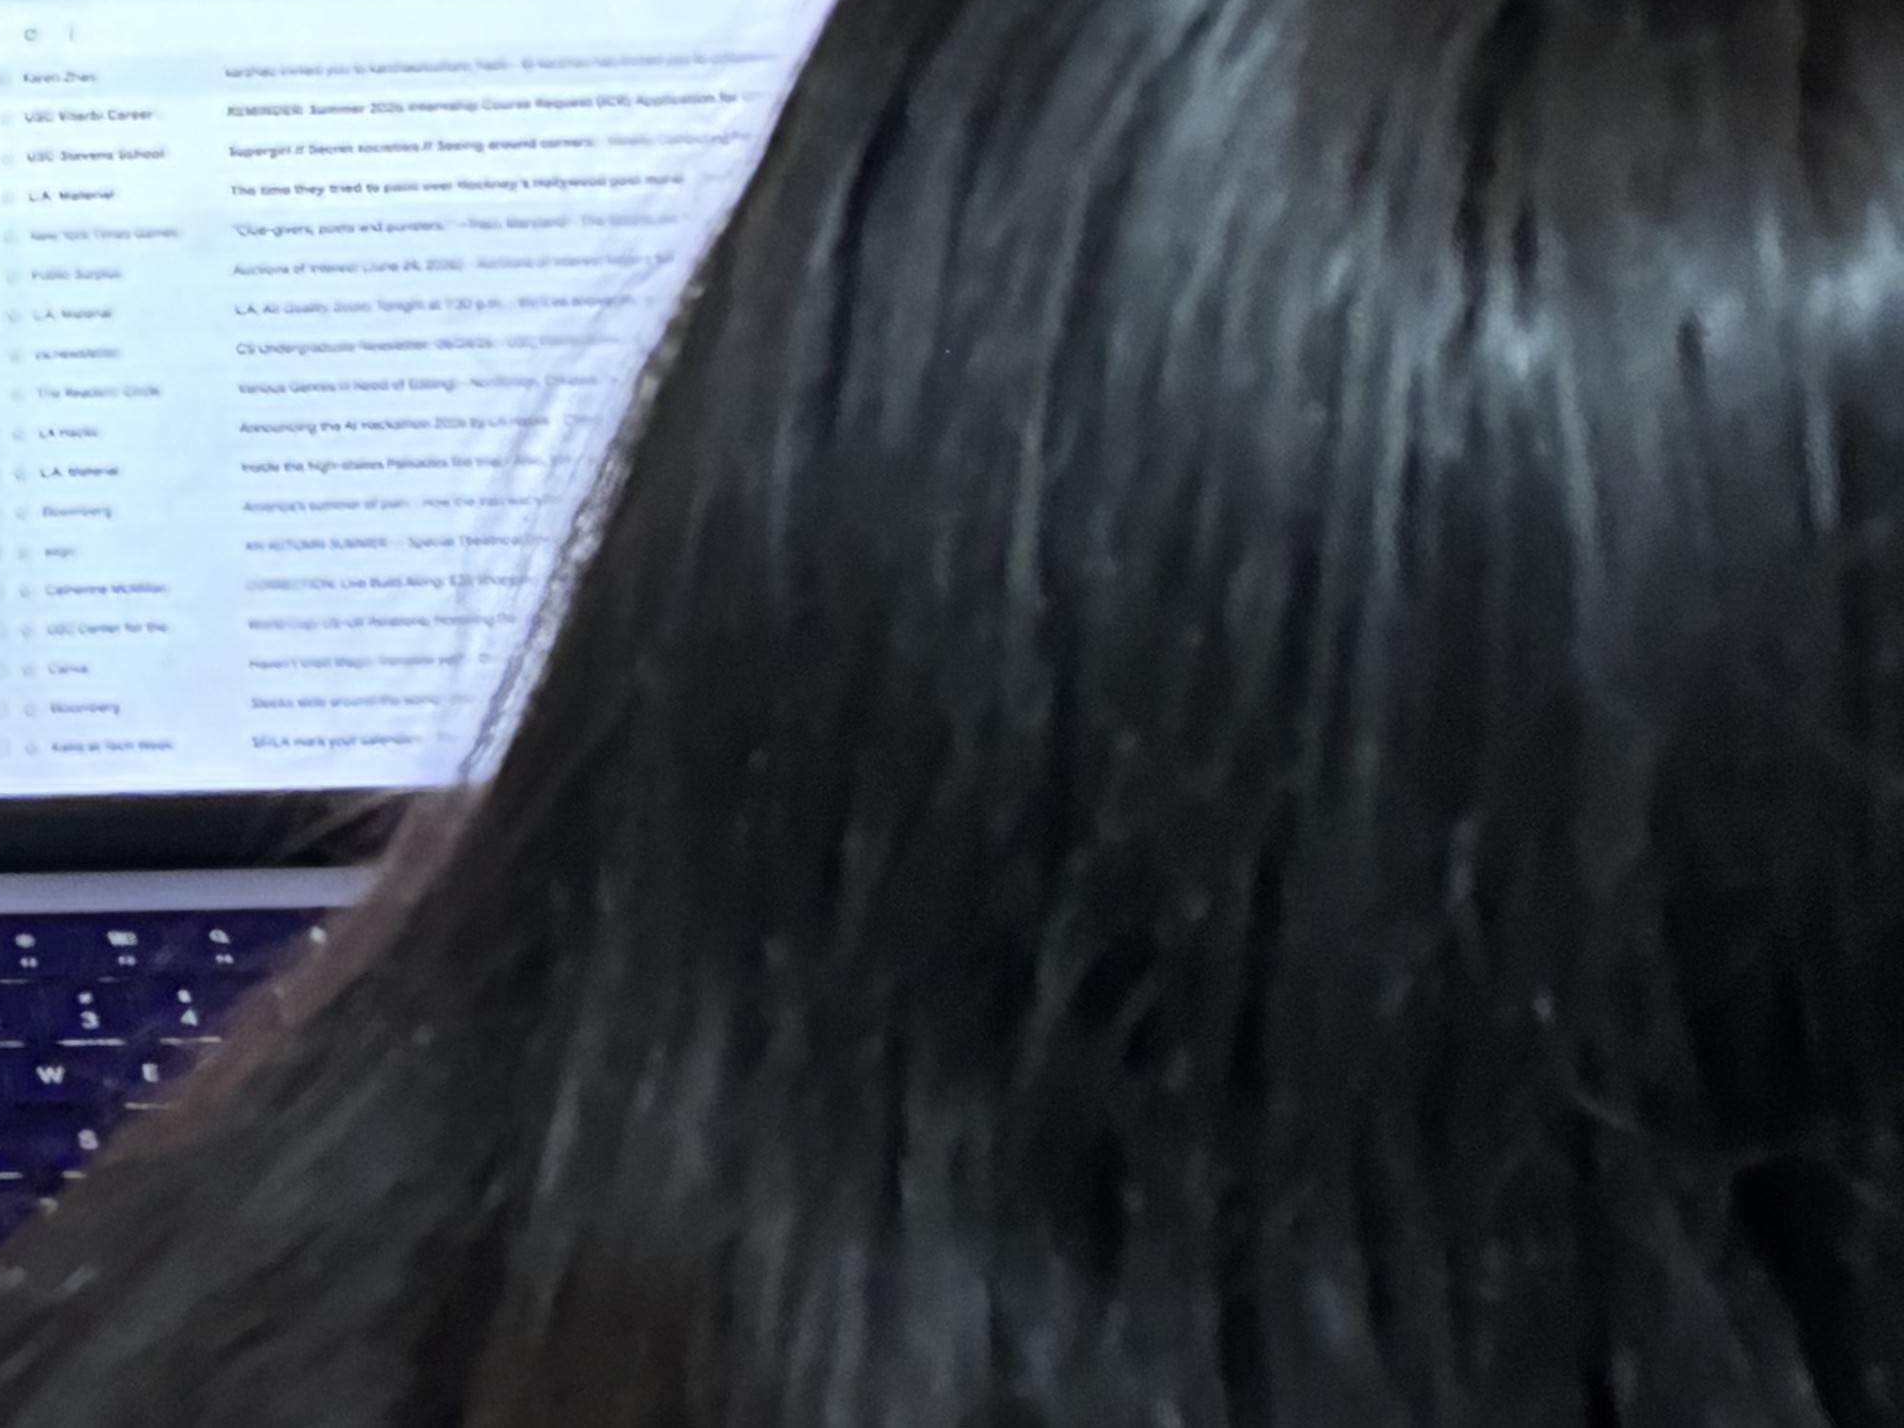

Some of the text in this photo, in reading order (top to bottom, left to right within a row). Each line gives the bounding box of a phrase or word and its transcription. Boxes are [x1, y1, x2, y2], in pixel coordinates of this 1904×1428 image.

[294, 183, 325, 197] they
[329, 182, 362, 193] tried
[35, 1064, 66, 1084] W
